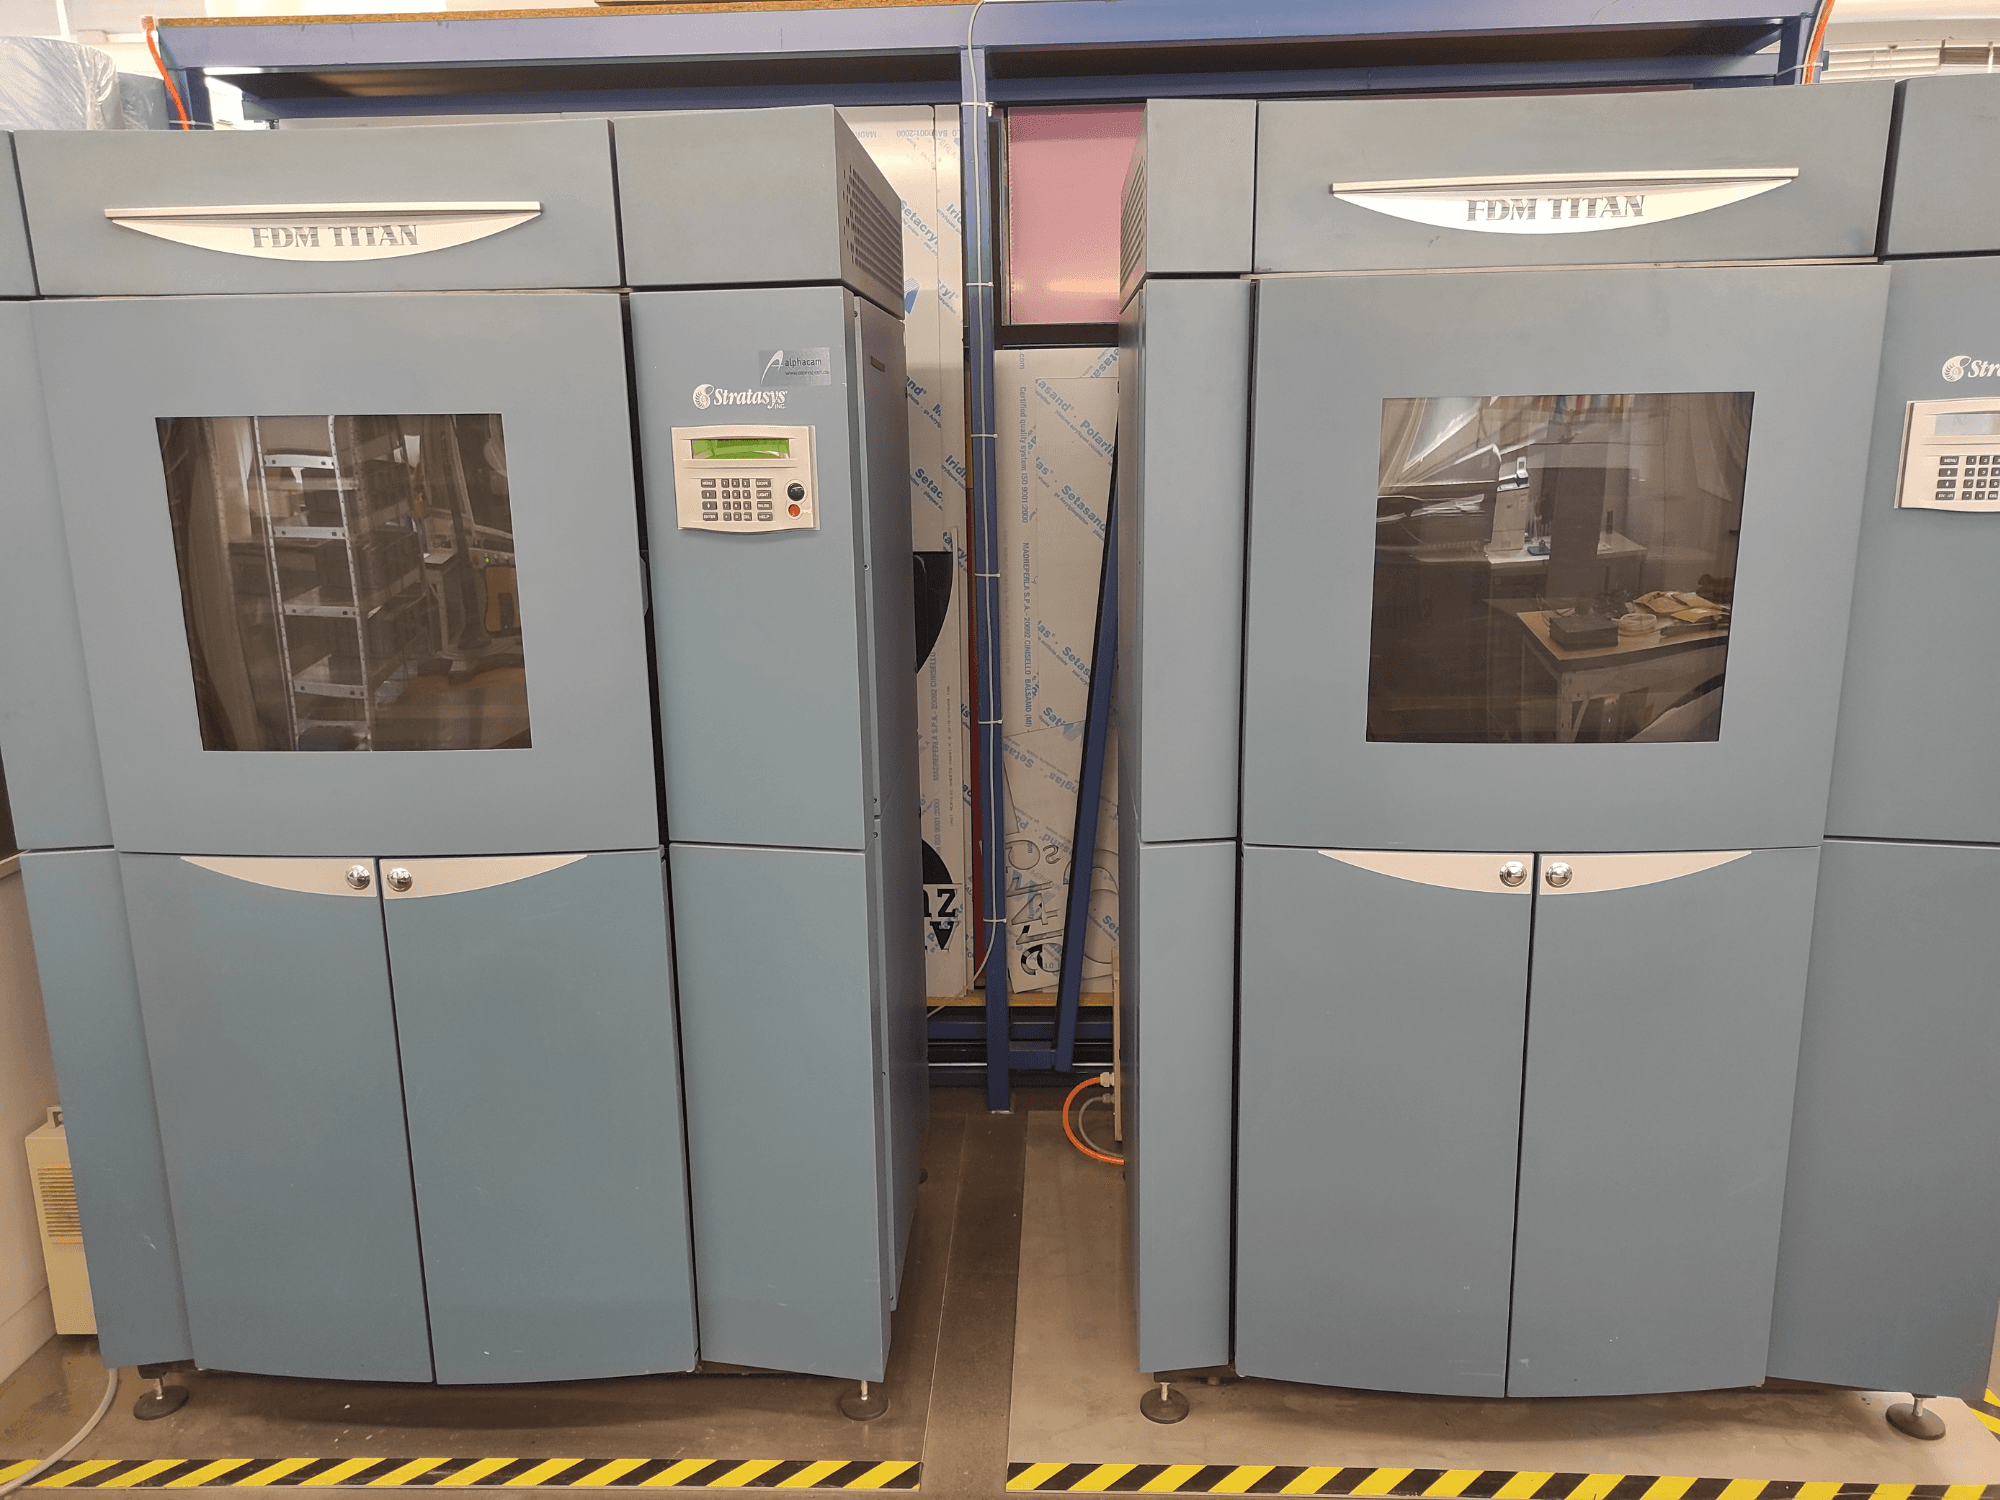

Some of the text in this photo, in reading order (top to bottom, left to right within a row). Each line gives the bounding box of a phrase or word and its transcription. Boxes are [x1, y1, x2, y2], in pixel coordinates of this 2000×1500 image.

[1466, 195, 1645, 221] FDM TITAN
[251, 225, 419, 248] FDM TITAN
[785, 358, 822, 368] alphacam
[714, 388, 787, 409] Stratasys
